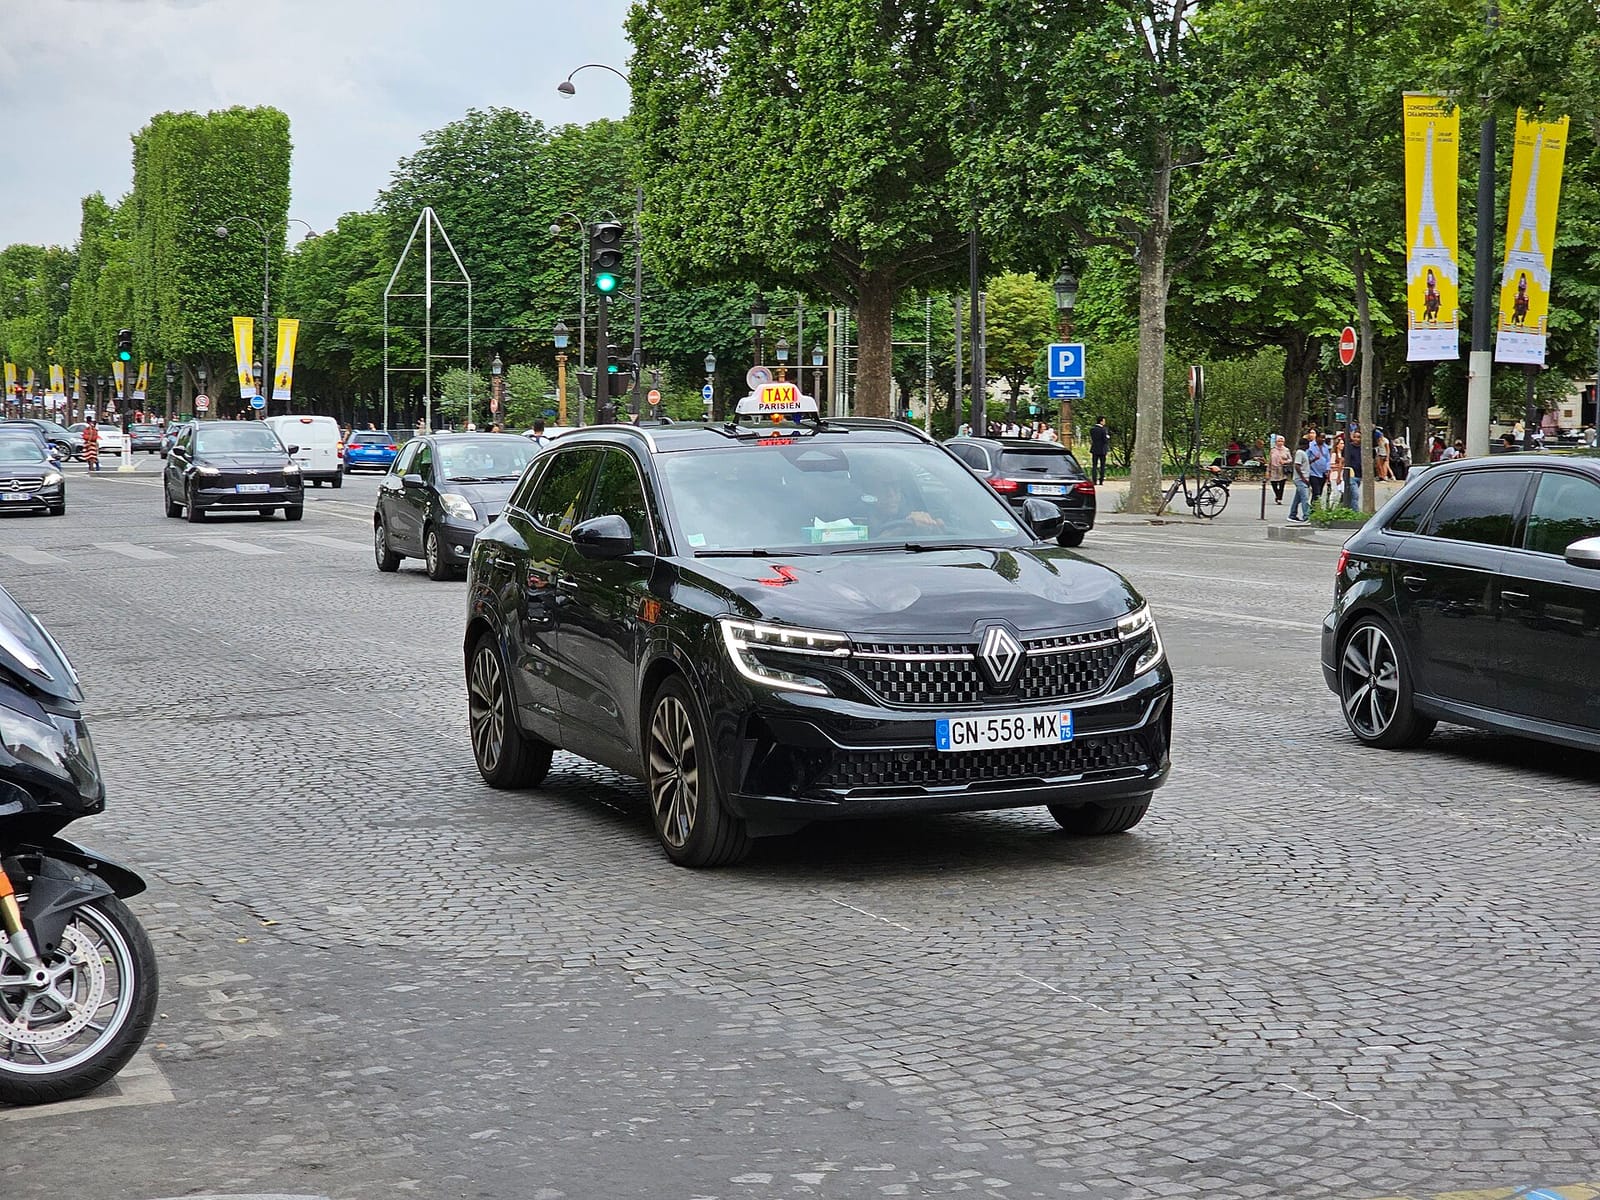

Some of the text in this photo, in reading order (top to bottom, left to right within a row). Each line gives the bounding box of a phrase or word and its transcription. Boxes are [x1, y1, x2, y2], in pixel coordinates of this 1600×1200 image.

[1059, 351, 1075, 373] P
[765, 387, 796, 402] TAXI
[759, 402, 801, 410] PARISIEN
[952, 714, 1058, 745] GN-558-MX
[1061, 727, 1071, 738] 75
[941, 738, 947, 746] F
